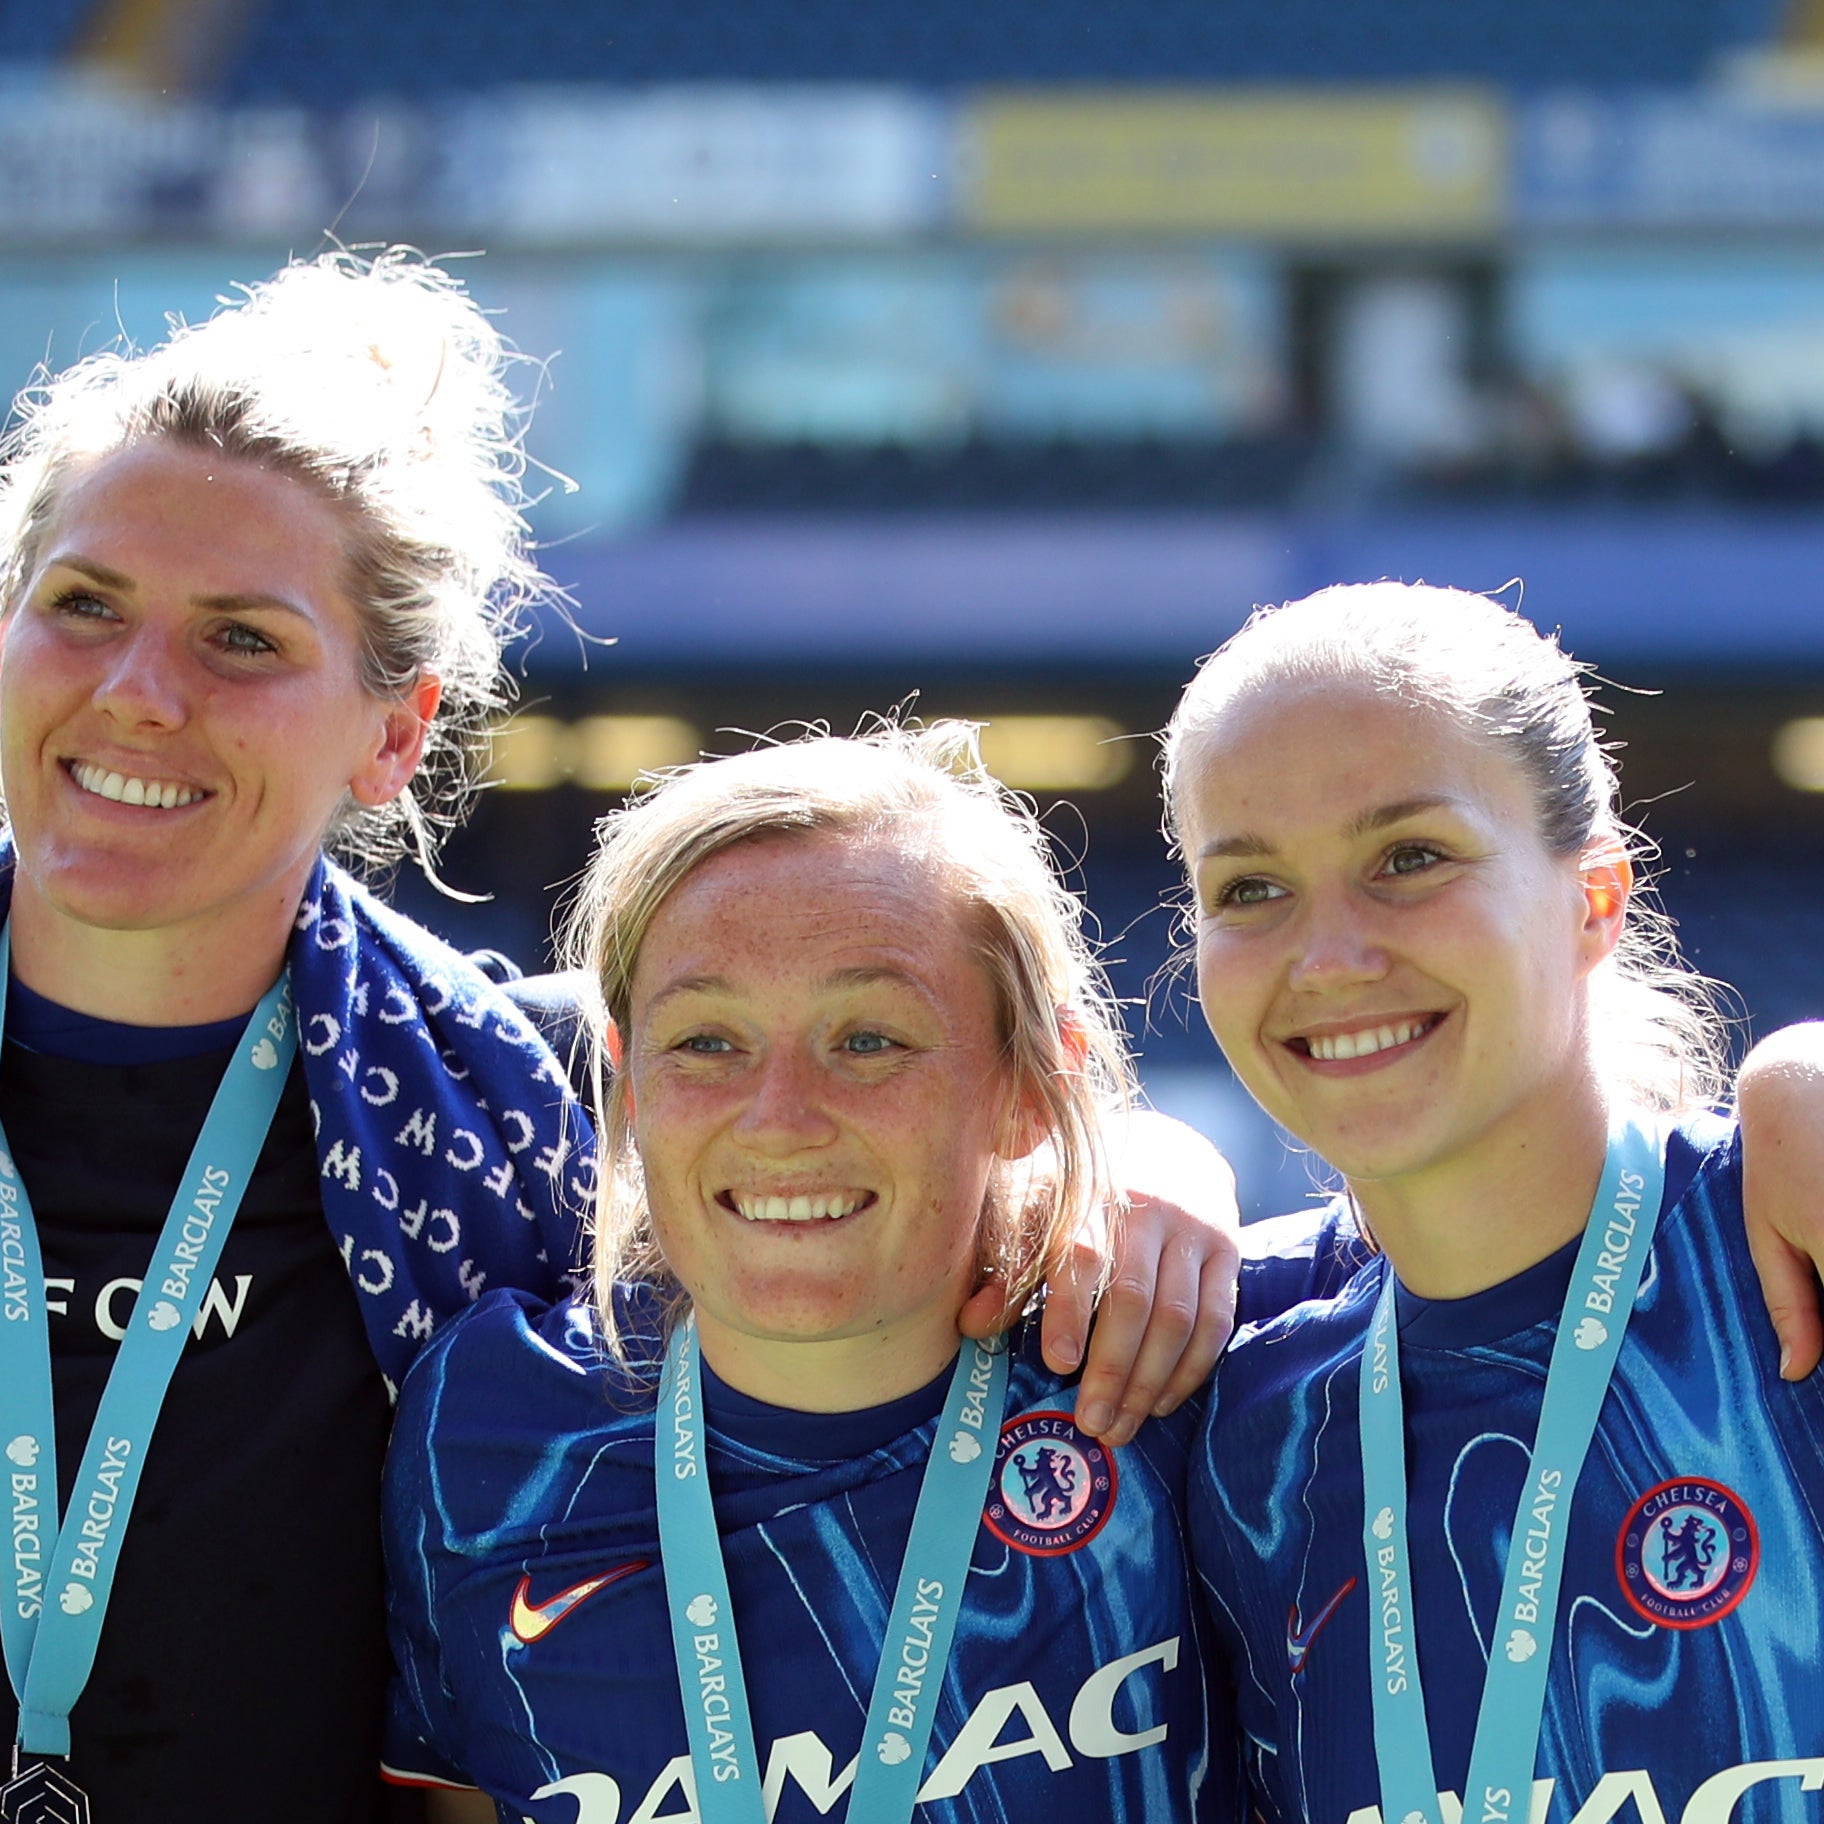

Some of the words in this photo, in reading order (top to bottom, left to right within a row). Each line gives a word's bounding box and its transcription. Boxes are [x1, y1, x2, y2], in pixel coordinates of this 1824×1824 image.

[161, 1165, 230, 1301] BARCLAYS
[1585, 1169, 1644, 1315] BARCLAYS
[11, 1473, 43, 1619] BARCLAYS
[71, 1436, 131, 1580] BARCLAYS
[1013, 1529, 1073, 1546] FOOTBALL
[1076, 1509, 1099, 1535] CLUB
[1514, 1468, 1562, 1624] BARCLAYS
[1643, 1486, 1728, 1517] CHELSEA
[888, 1577, 943, 1730] BARCLAYS
[1377, 1544, 1408, 1696] BARCLAYS
[1641, 1593, 1696, 1617] FOOTBALL
[1702, 1588, 1731, 1612] CLUB
[692, 1633, 739, 1784] BARCLAYS
